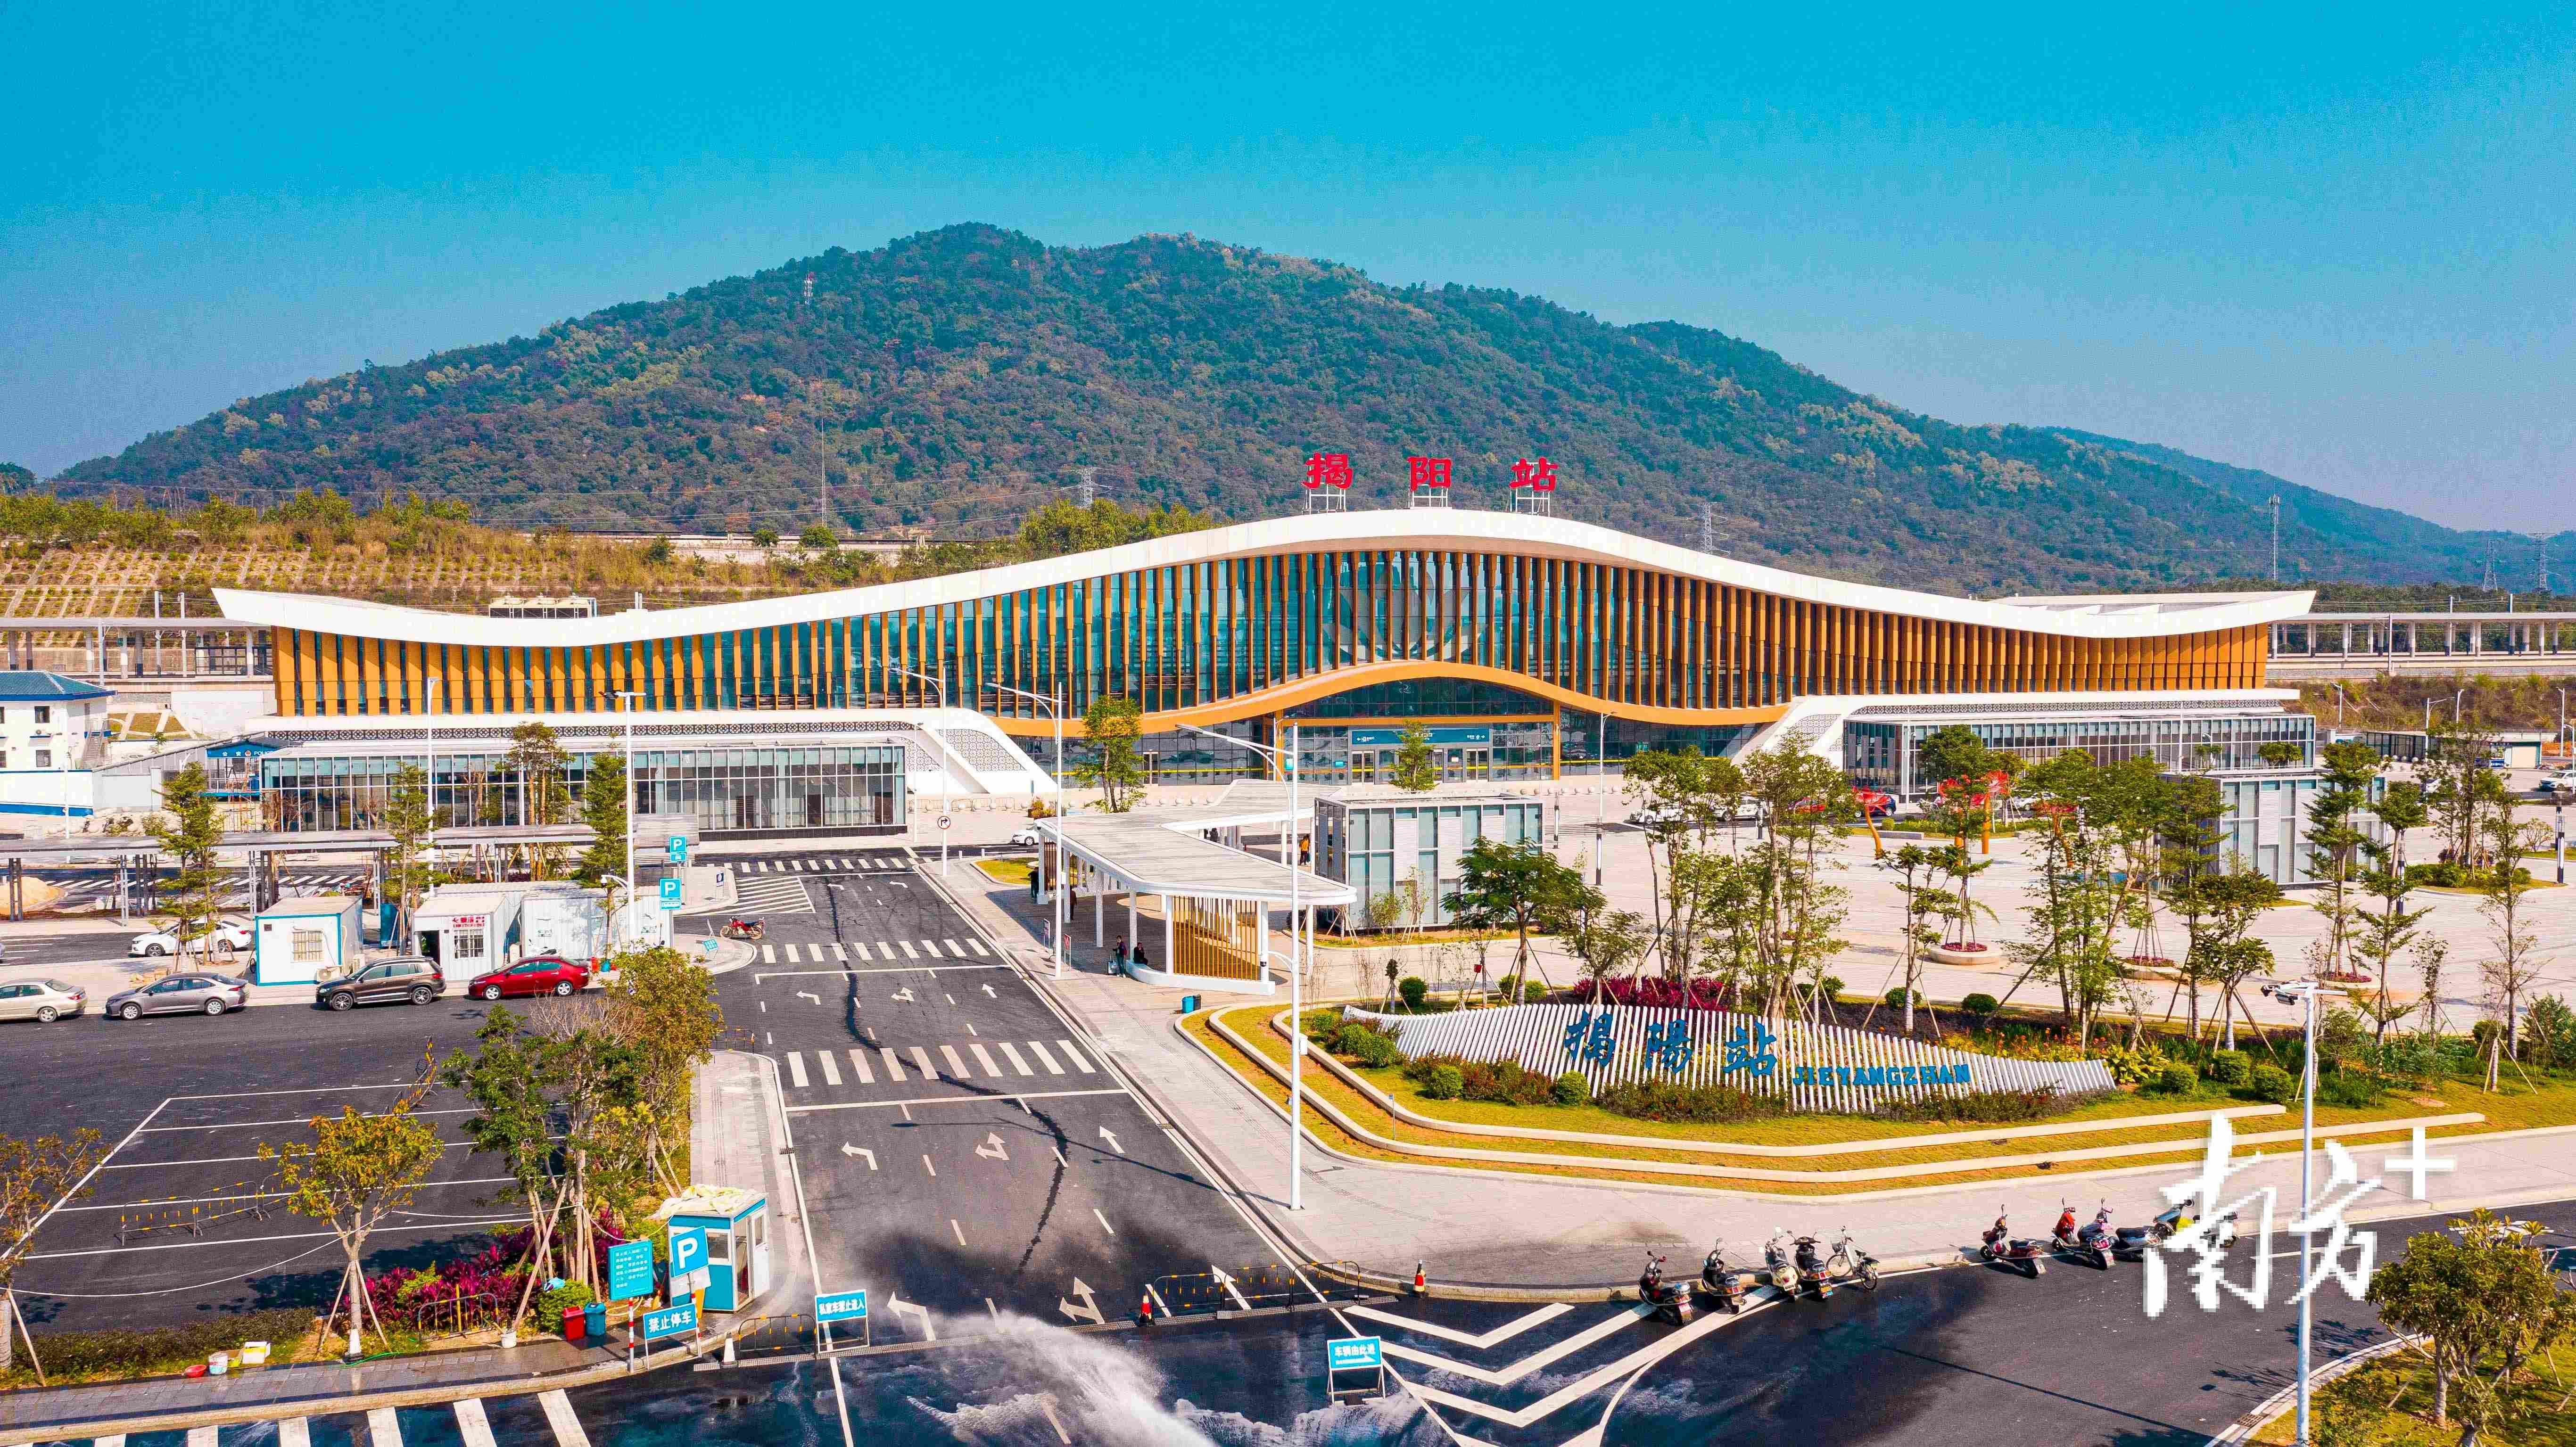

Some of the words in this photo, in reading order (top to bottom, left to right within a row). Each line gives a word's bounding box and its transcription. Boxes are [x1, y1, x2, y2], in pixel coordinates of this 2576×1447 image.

[1302, 452, 1558, 491] 揭阳站
[673, 839, 682, 851] P
[665, 882, 676, 896] P
[1792, 1064, 1970, 1086] JIEYANGZHAN
[677, 1237, 698, 1269] P
[648, 1310, 692, 1333] 禁止停车
